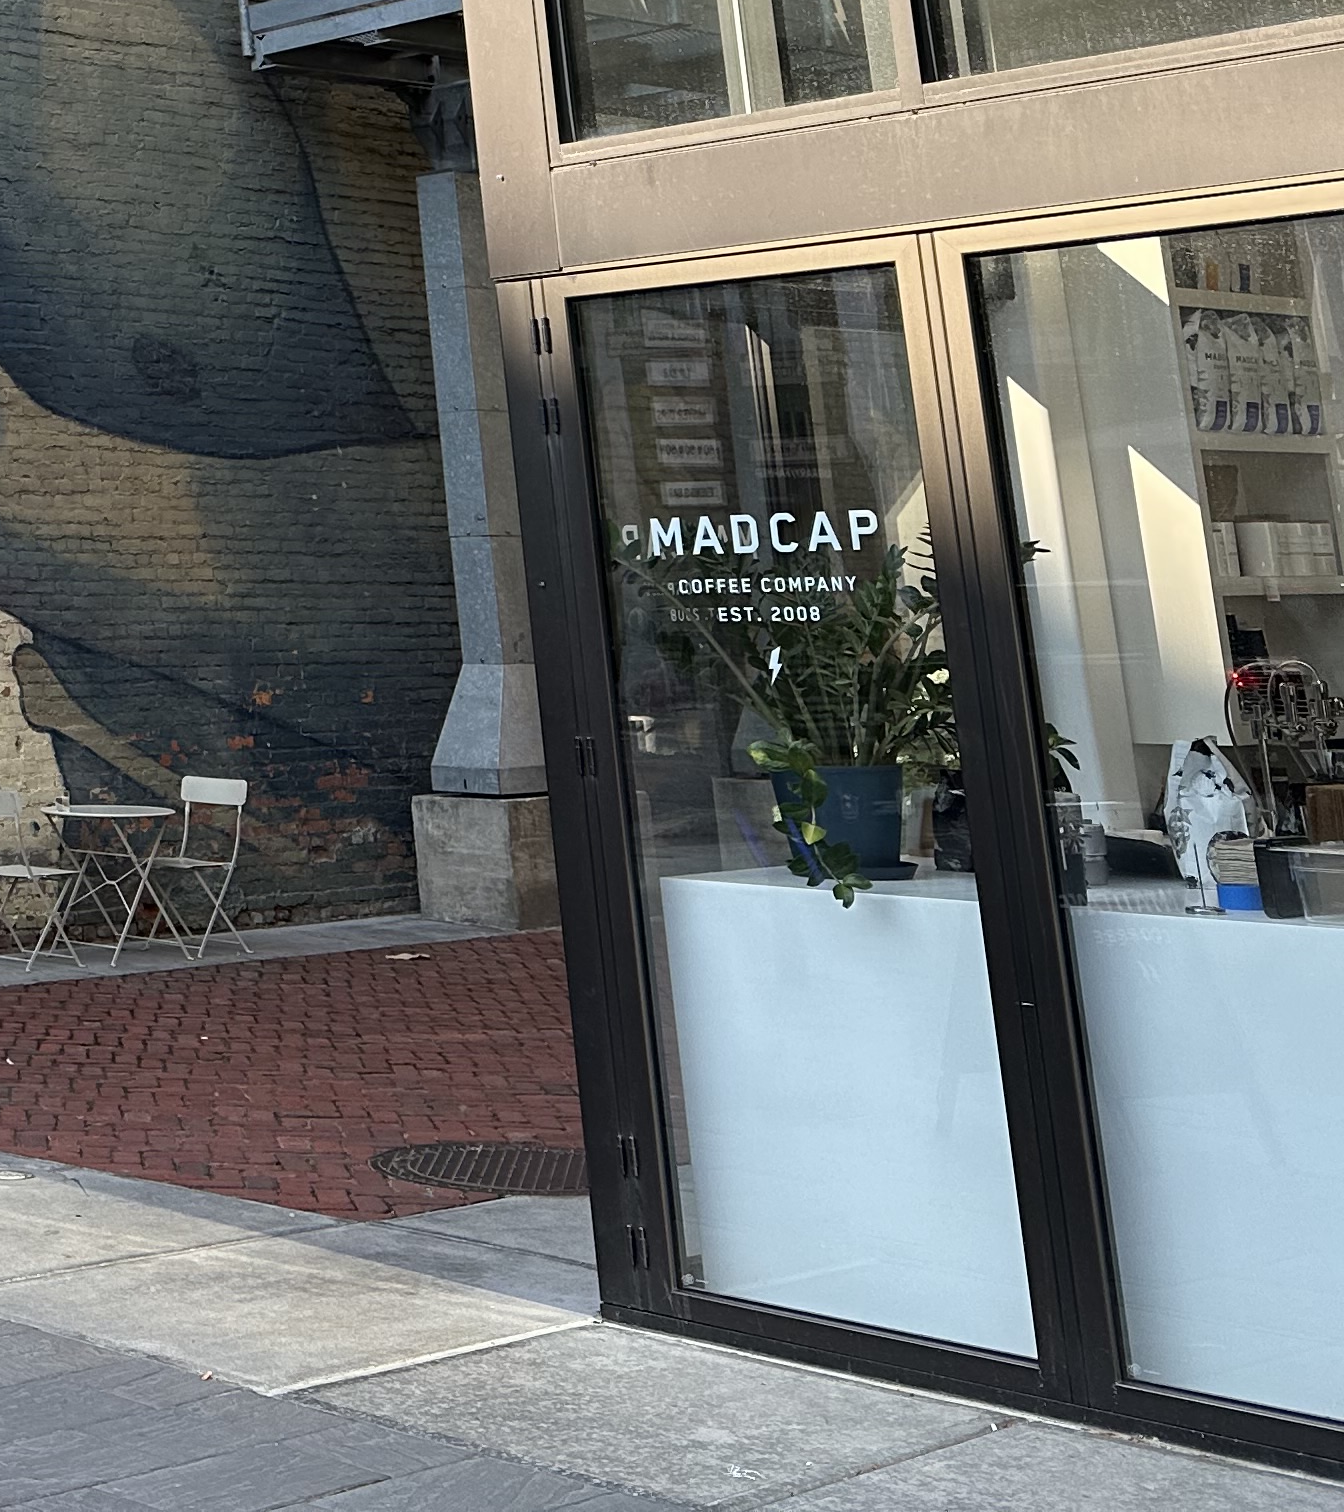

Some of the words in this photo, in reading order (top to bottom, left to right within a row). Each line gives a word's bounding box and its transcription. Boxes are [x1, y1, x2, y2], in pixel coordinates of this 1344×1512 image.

[649, 508, 879, 557] MADCAP
[678, 577, 752, 595] COFFEE
[760, 575, 857, 594] COMPANY
[718, 606, 762, 623] EST.
[771, 605, 821, 623] 2008
